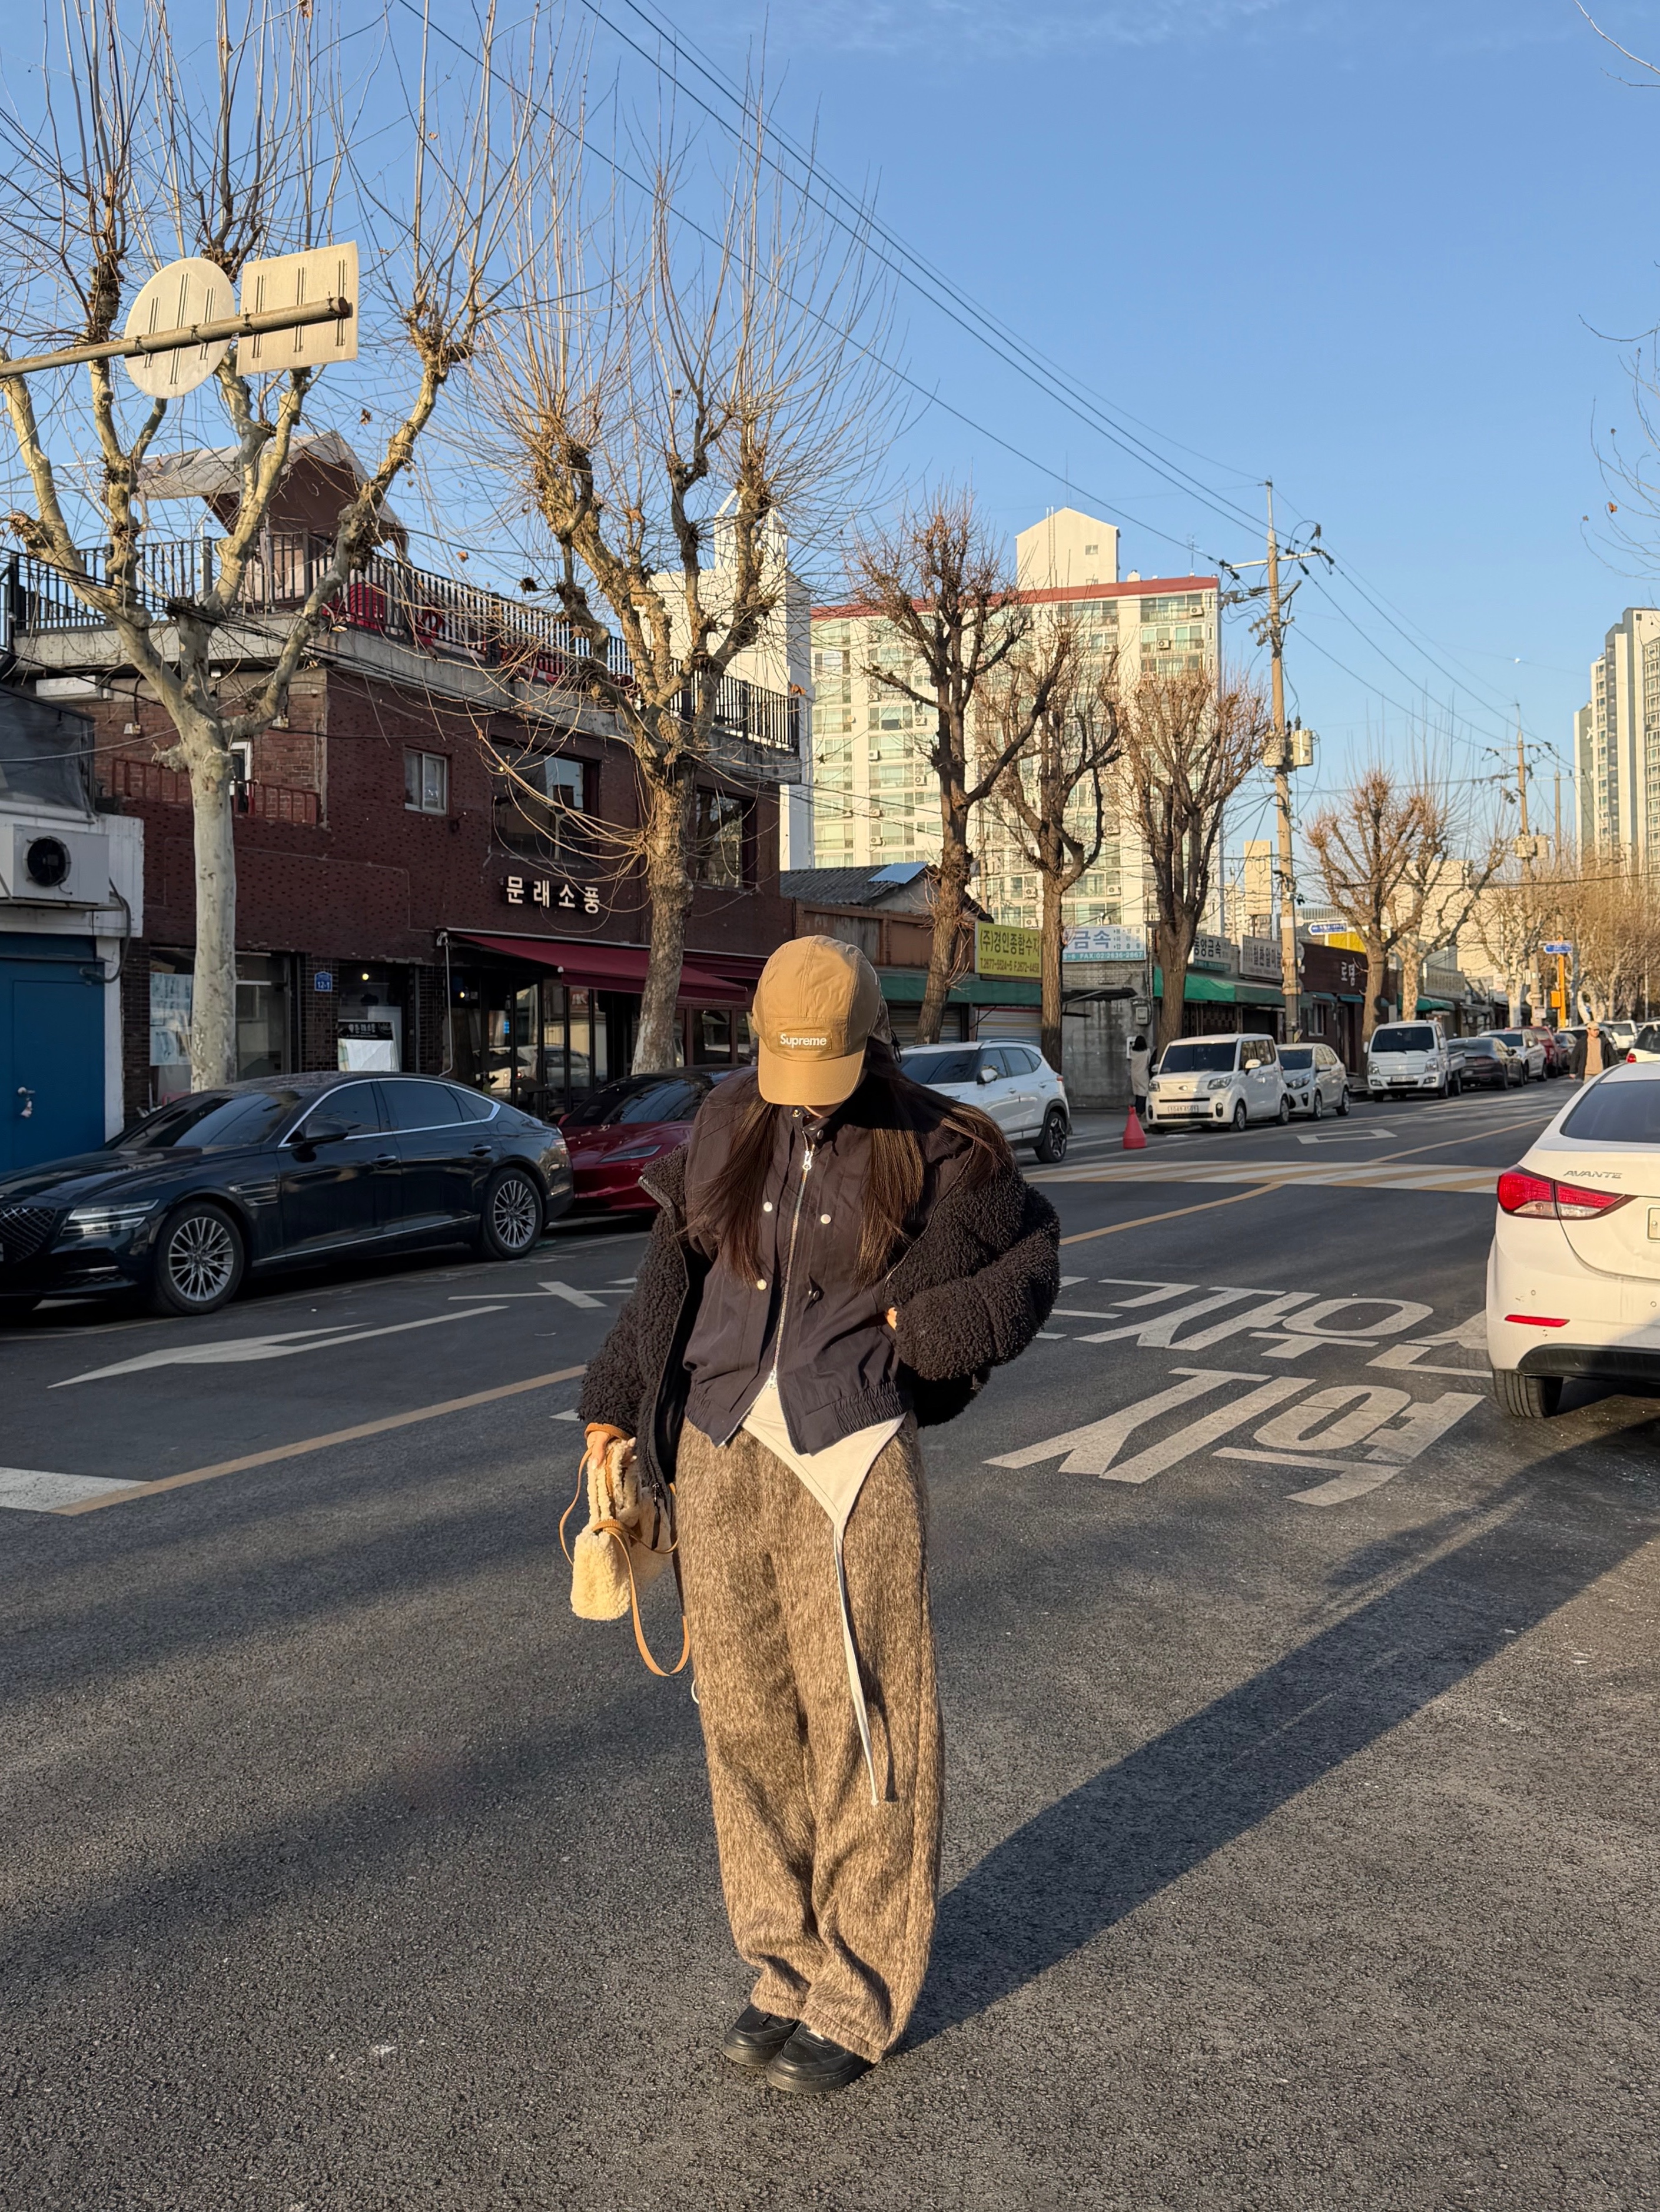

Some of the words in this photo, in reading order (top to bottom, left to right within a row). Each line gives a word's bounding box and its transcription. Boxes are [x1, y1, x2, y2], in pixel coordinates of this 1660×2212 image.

[506, 876, 600, 914] 문래소풍
[980, 929, 1040, 958] (주)경인종합수지
[317, 981, 330, 989] 12-1
[780, 1033, 827, 1049] Supreme
[1563, 1170, 1623, 1179] AVANTE
[982, 1367, 1486, 1506] 지역
